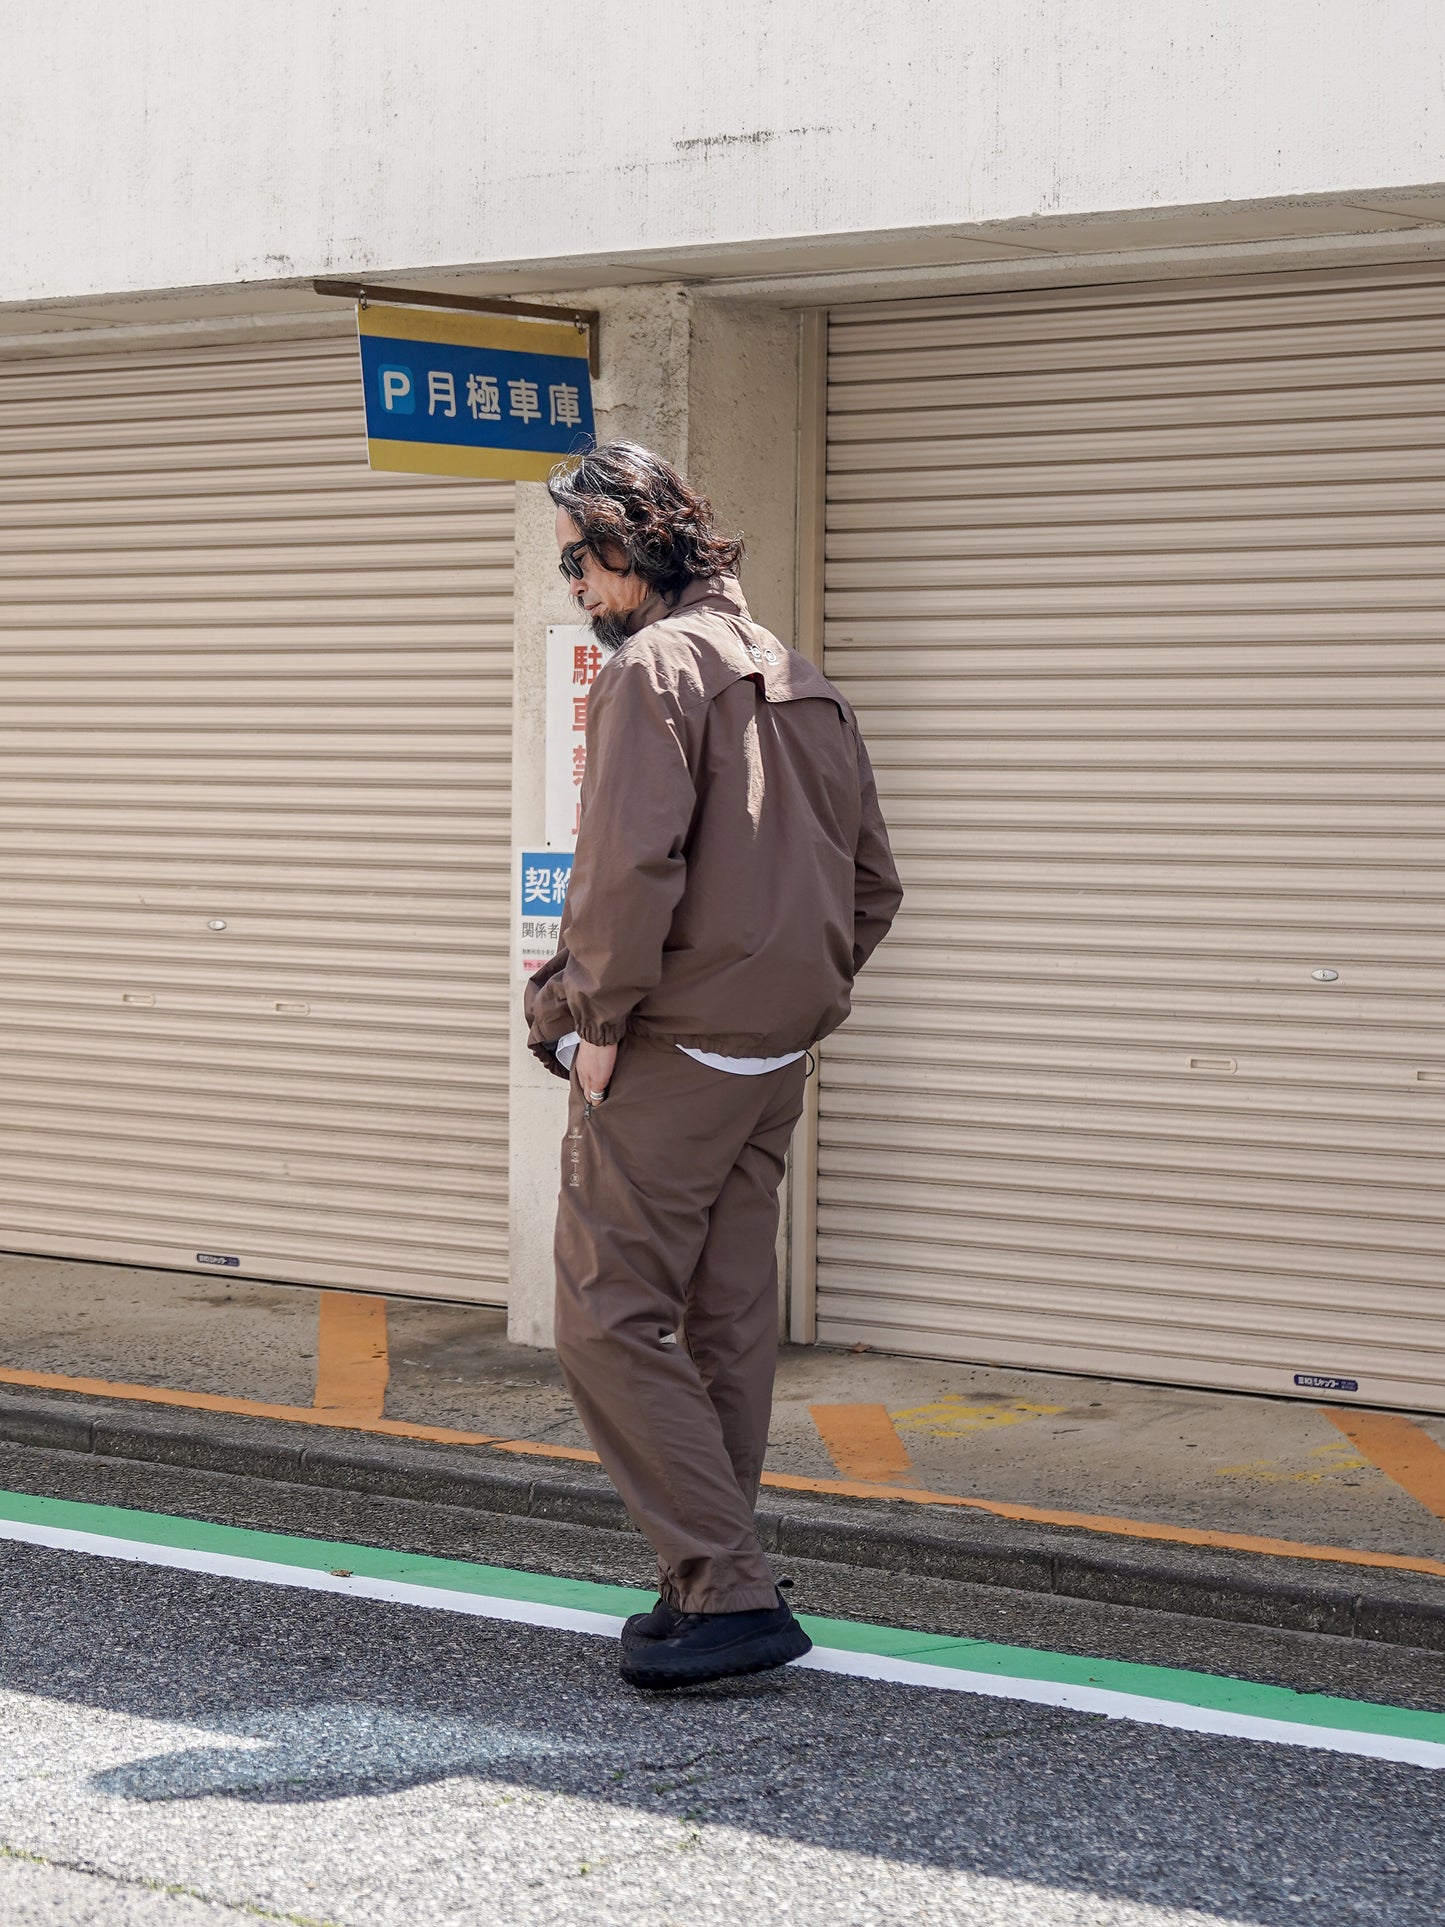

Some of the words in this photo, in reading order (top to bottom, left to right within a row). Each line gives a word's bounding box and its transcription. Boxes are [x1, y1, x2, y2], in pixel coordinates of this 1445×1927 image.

[383, 371, 411, 411] P
[428, 370, 583, 429] 月極車庫
[521, 921, 560, 940] 関係者
